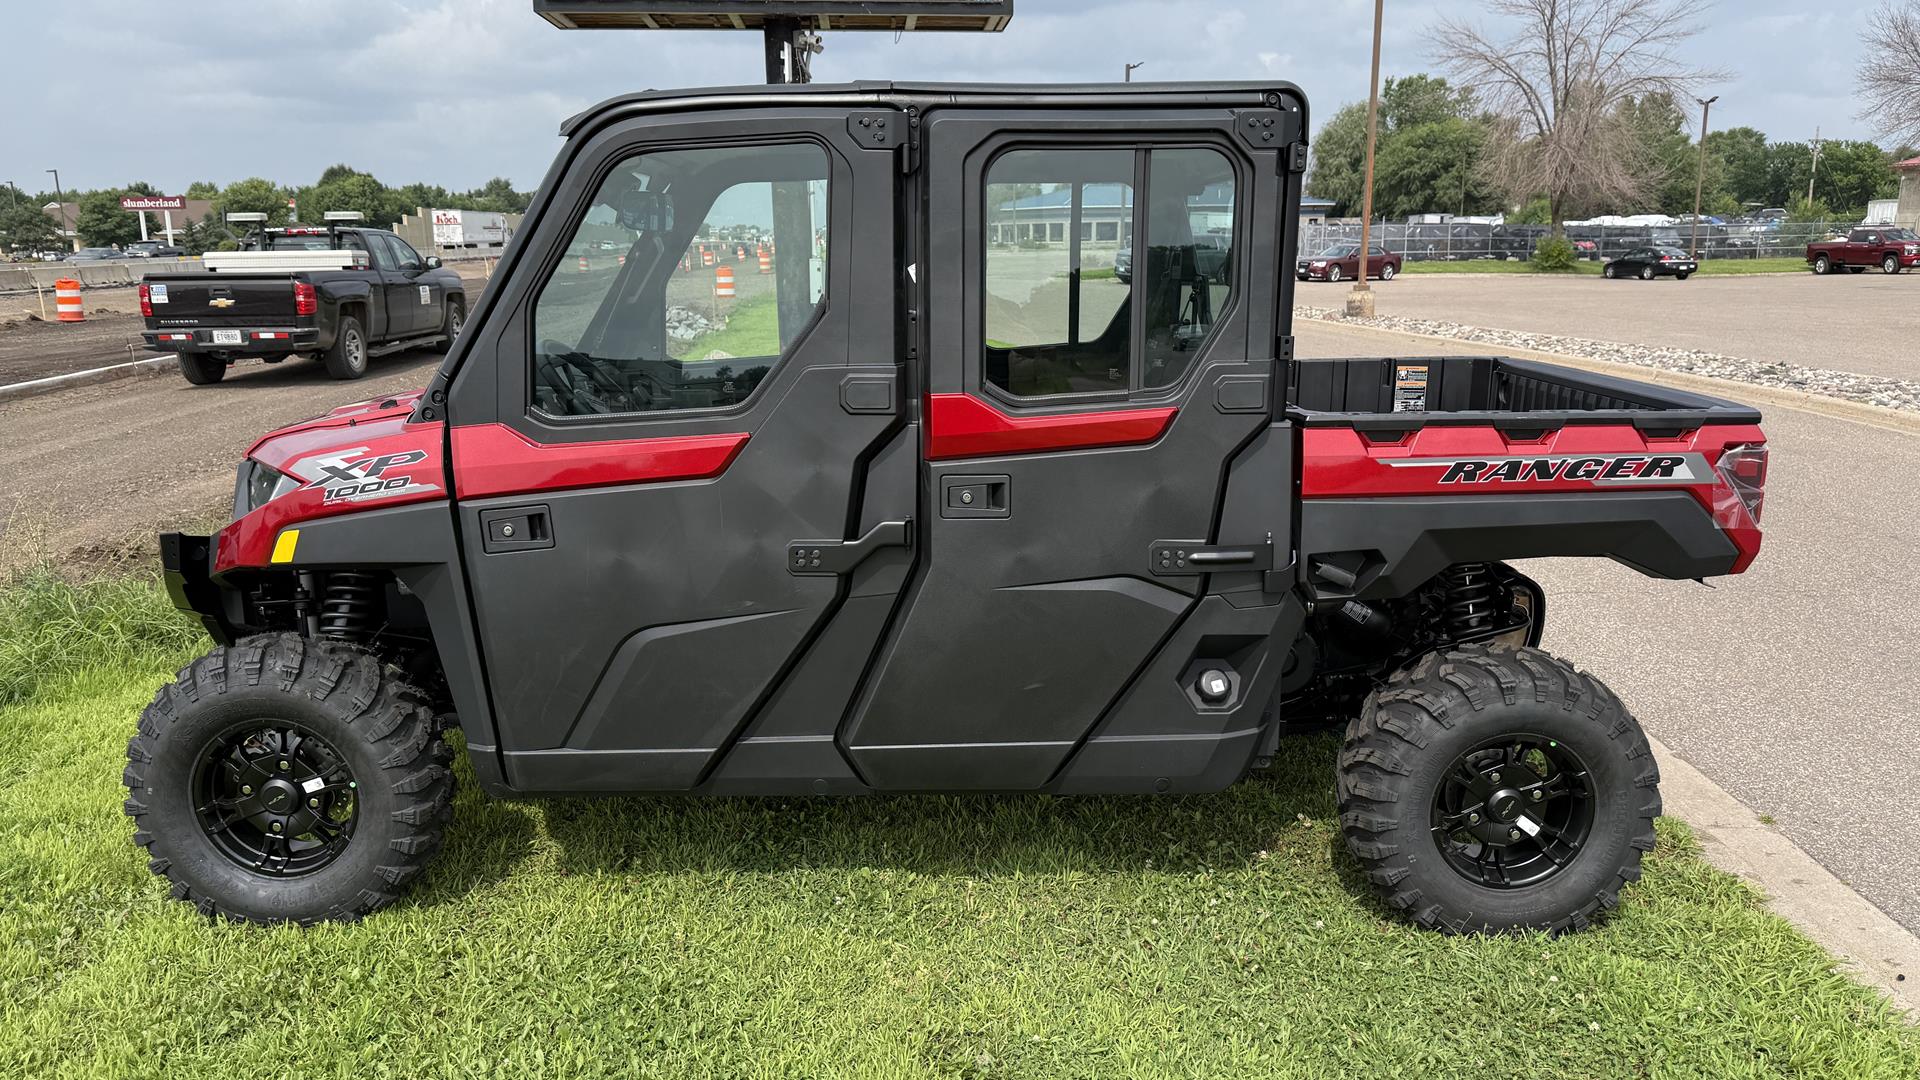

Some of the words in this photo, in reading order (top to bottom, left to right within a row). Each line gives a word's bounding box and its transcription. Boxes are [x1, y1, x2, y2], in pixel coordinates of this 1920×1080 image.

[123, 198, 181, 207] slumberland
[436, 213, 458, 224] Koch
[303, 450, 428, 489] XP
[1439, 456, 1685, 483] RANGER
[323, 475, 411, 501] 1000
